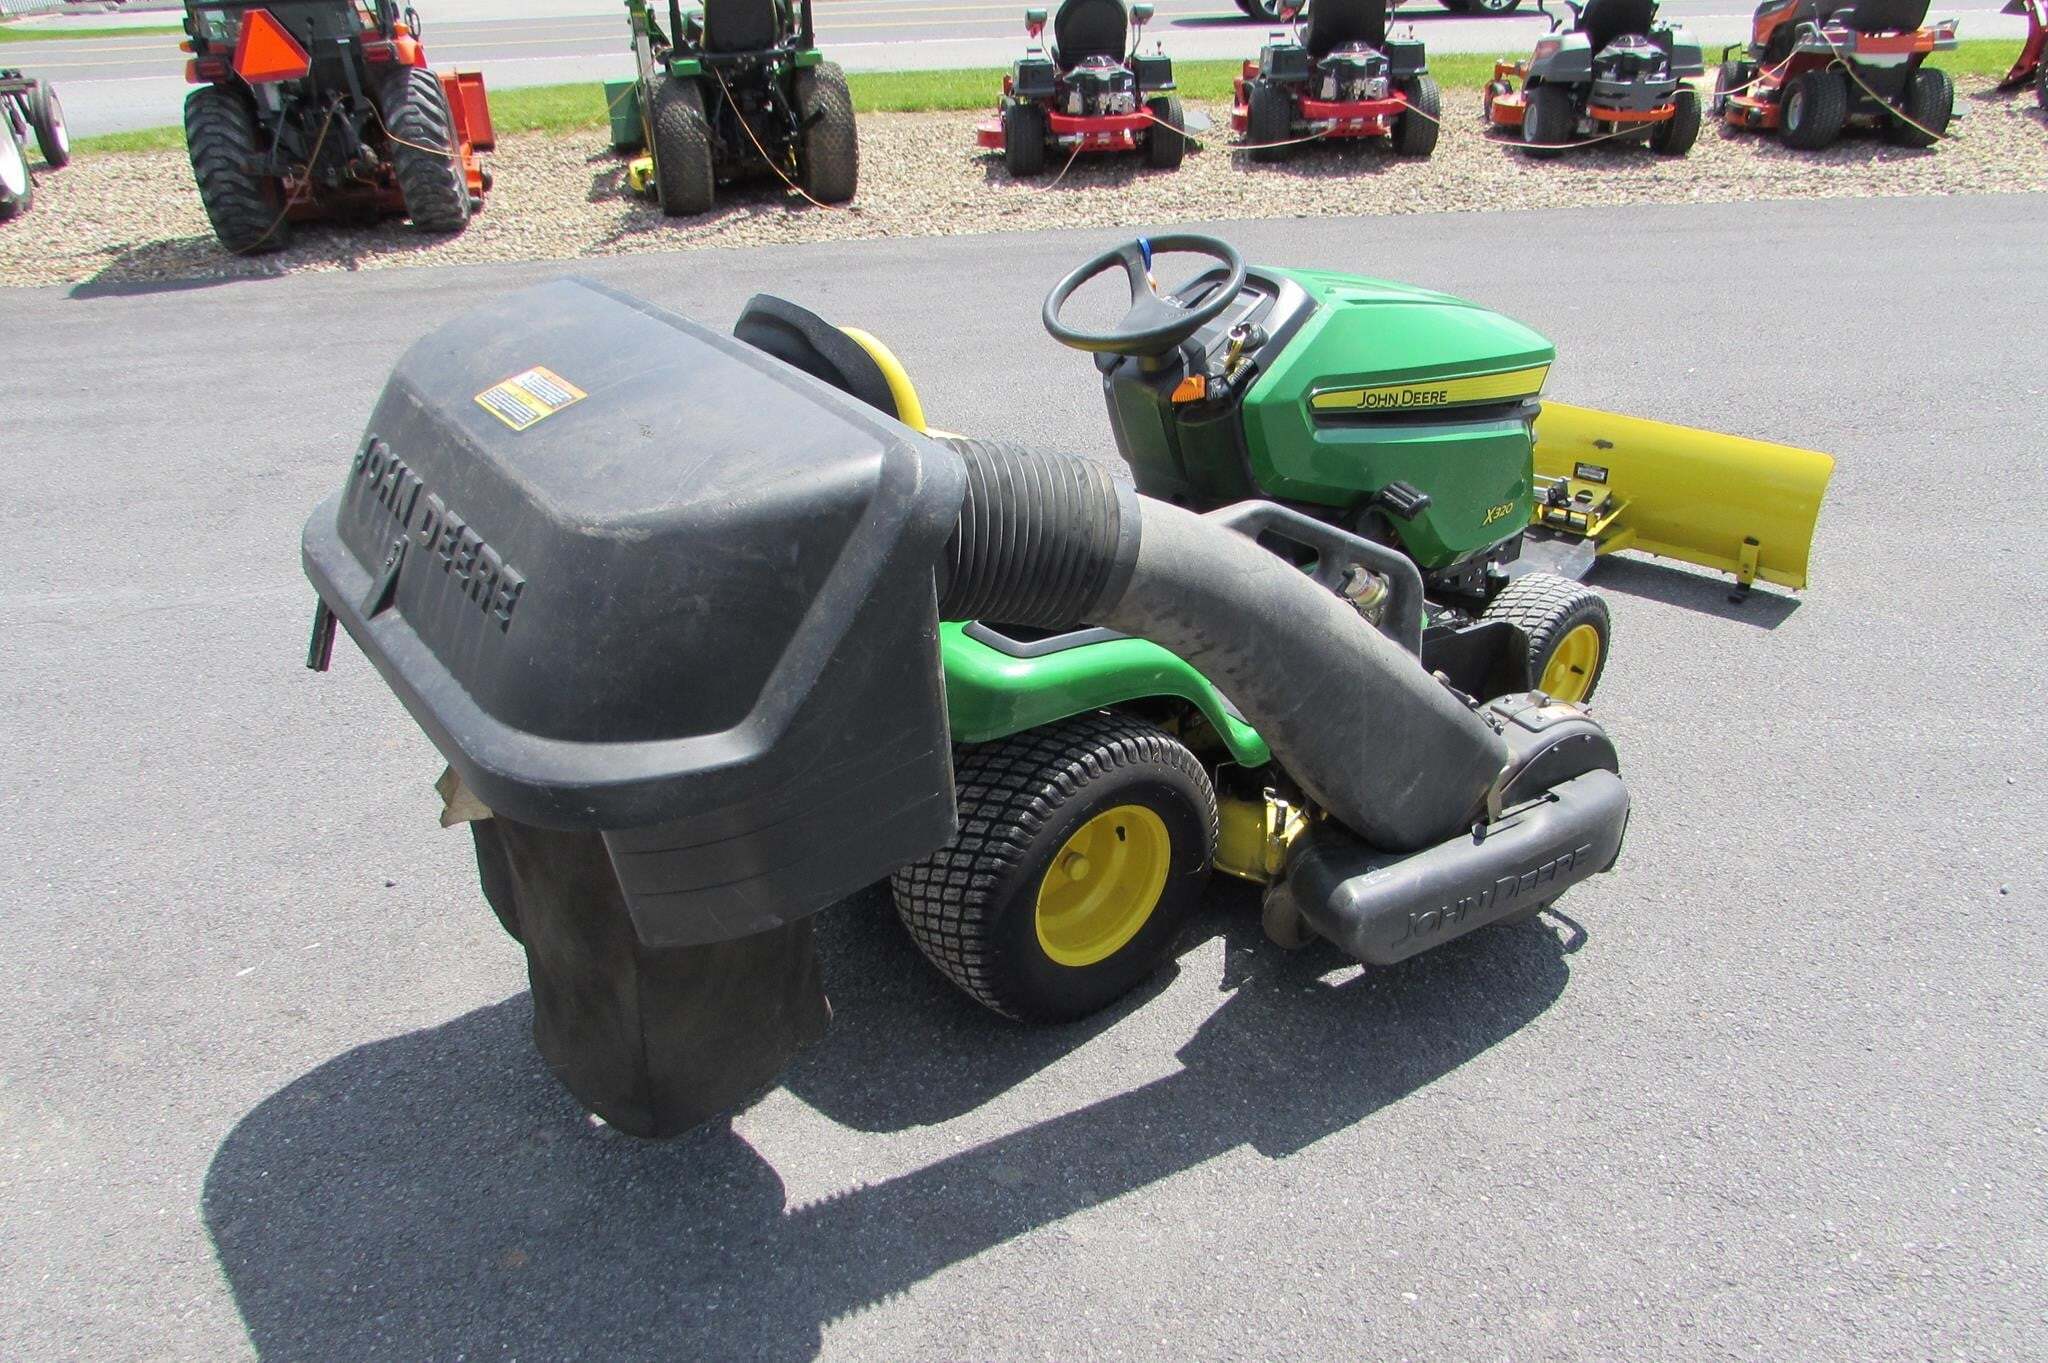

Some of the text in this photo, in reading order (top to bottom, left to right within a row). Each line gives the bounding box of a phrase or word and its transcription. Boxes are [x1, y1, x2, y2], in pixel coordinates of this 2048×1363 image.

[1357, 389, 1448, 408] JOHN DEERE
[355, 433, 526, 635] JOHN DEERE
[1483, 502, 1514, 525] X320
[1391, 890, 1491, 949] JOHN
